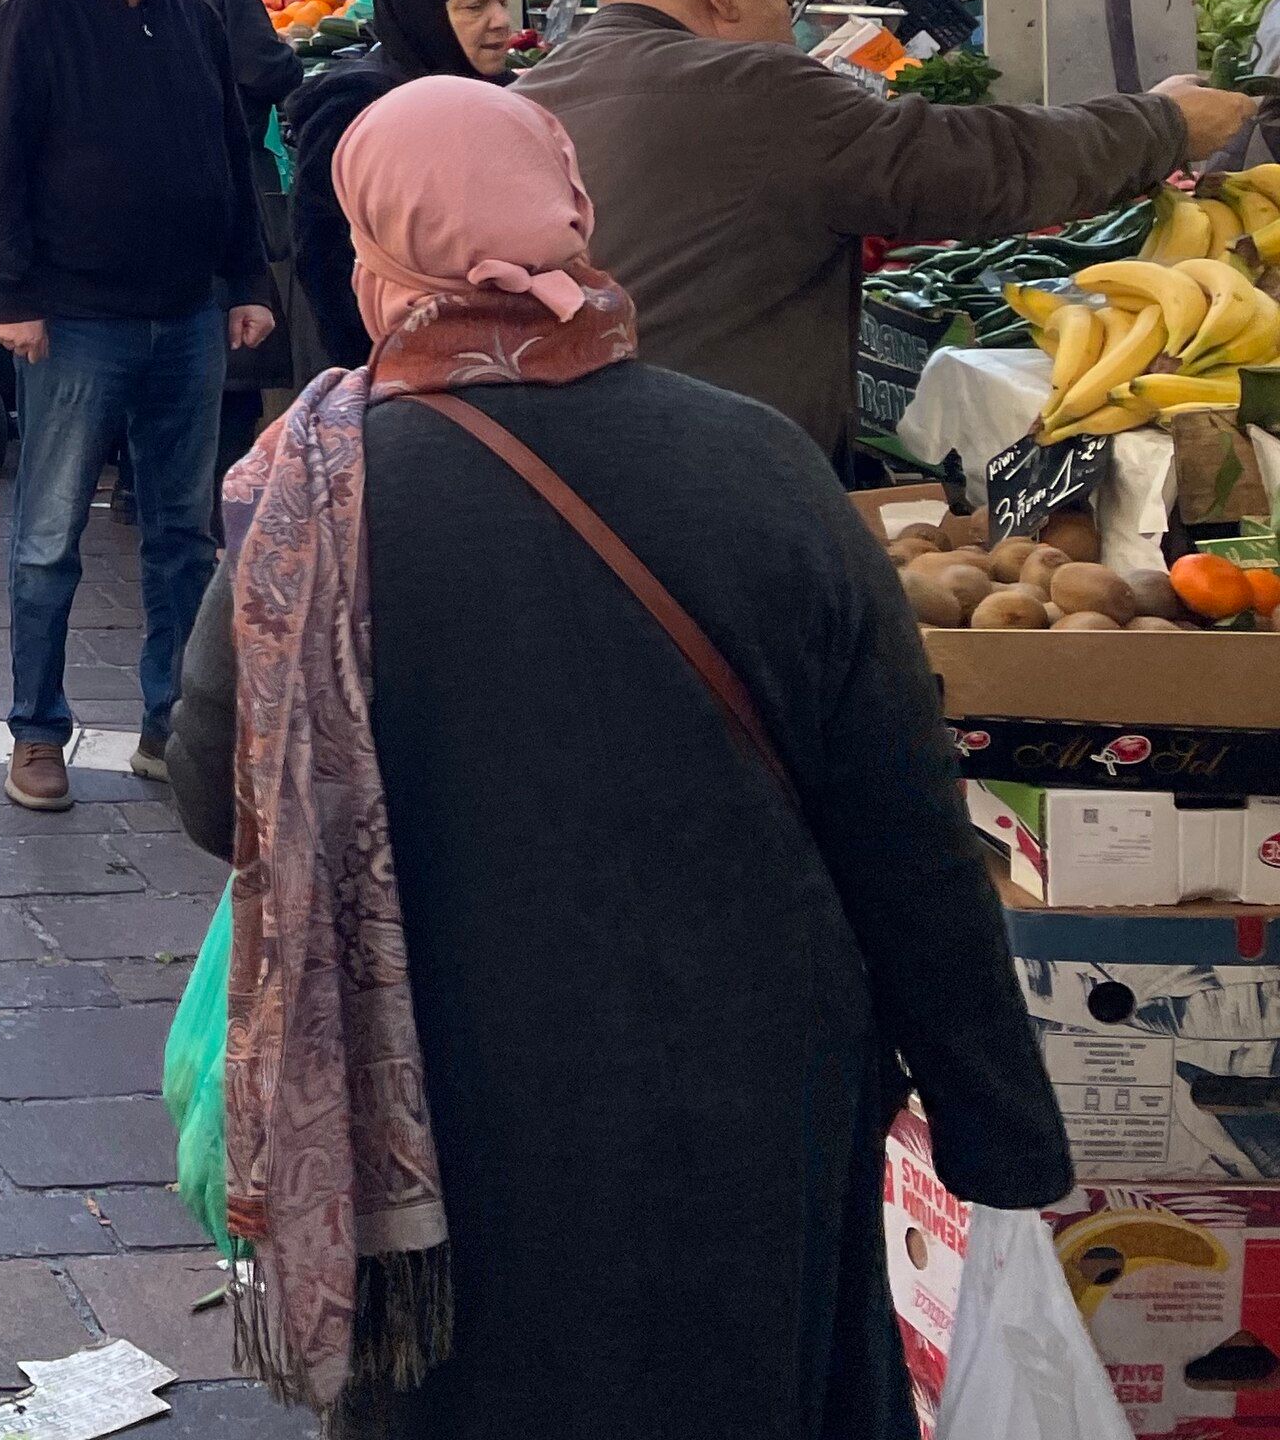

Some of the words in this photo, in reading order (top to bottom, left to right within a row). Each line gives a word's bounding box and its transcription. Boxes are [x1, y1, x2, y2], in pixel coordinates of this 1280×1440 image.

[901, 1158, 969, 1229] ANANAS
[902, 1186, 968, 1260] REMIUM
[1103, 1364, 1165, 1383] BANA
